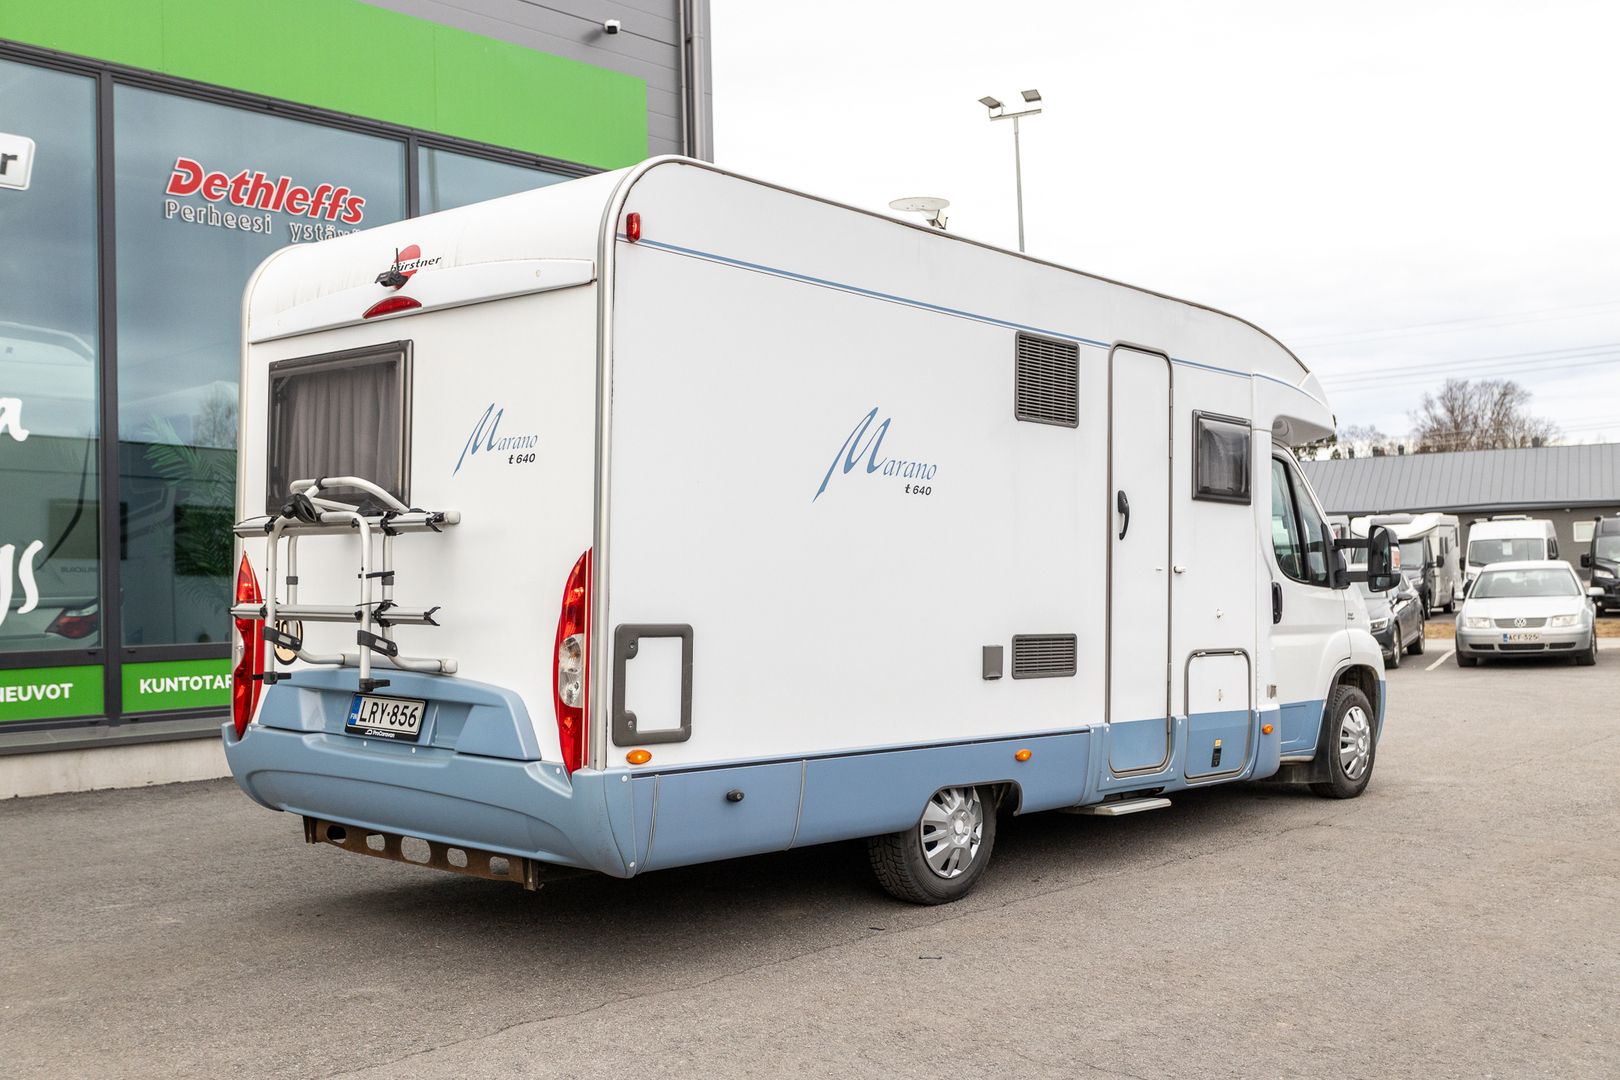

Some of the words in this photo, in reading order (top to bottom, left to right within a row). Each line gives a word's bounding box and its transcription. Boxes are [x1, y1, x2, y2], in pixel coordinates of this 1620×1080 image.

[166, 157, 366, 225] Dethleffs
[165, 199, 272, 234] Perheesi
[289, 222, 361, 243] ystä
[452, 402, 538, 477] Marano
[516, 453, 536, 464] 640
[812, 406, 938, 503] Marano
[912, 485, 932, 496] 640
[358, 700, 419, 728] LRY-856
